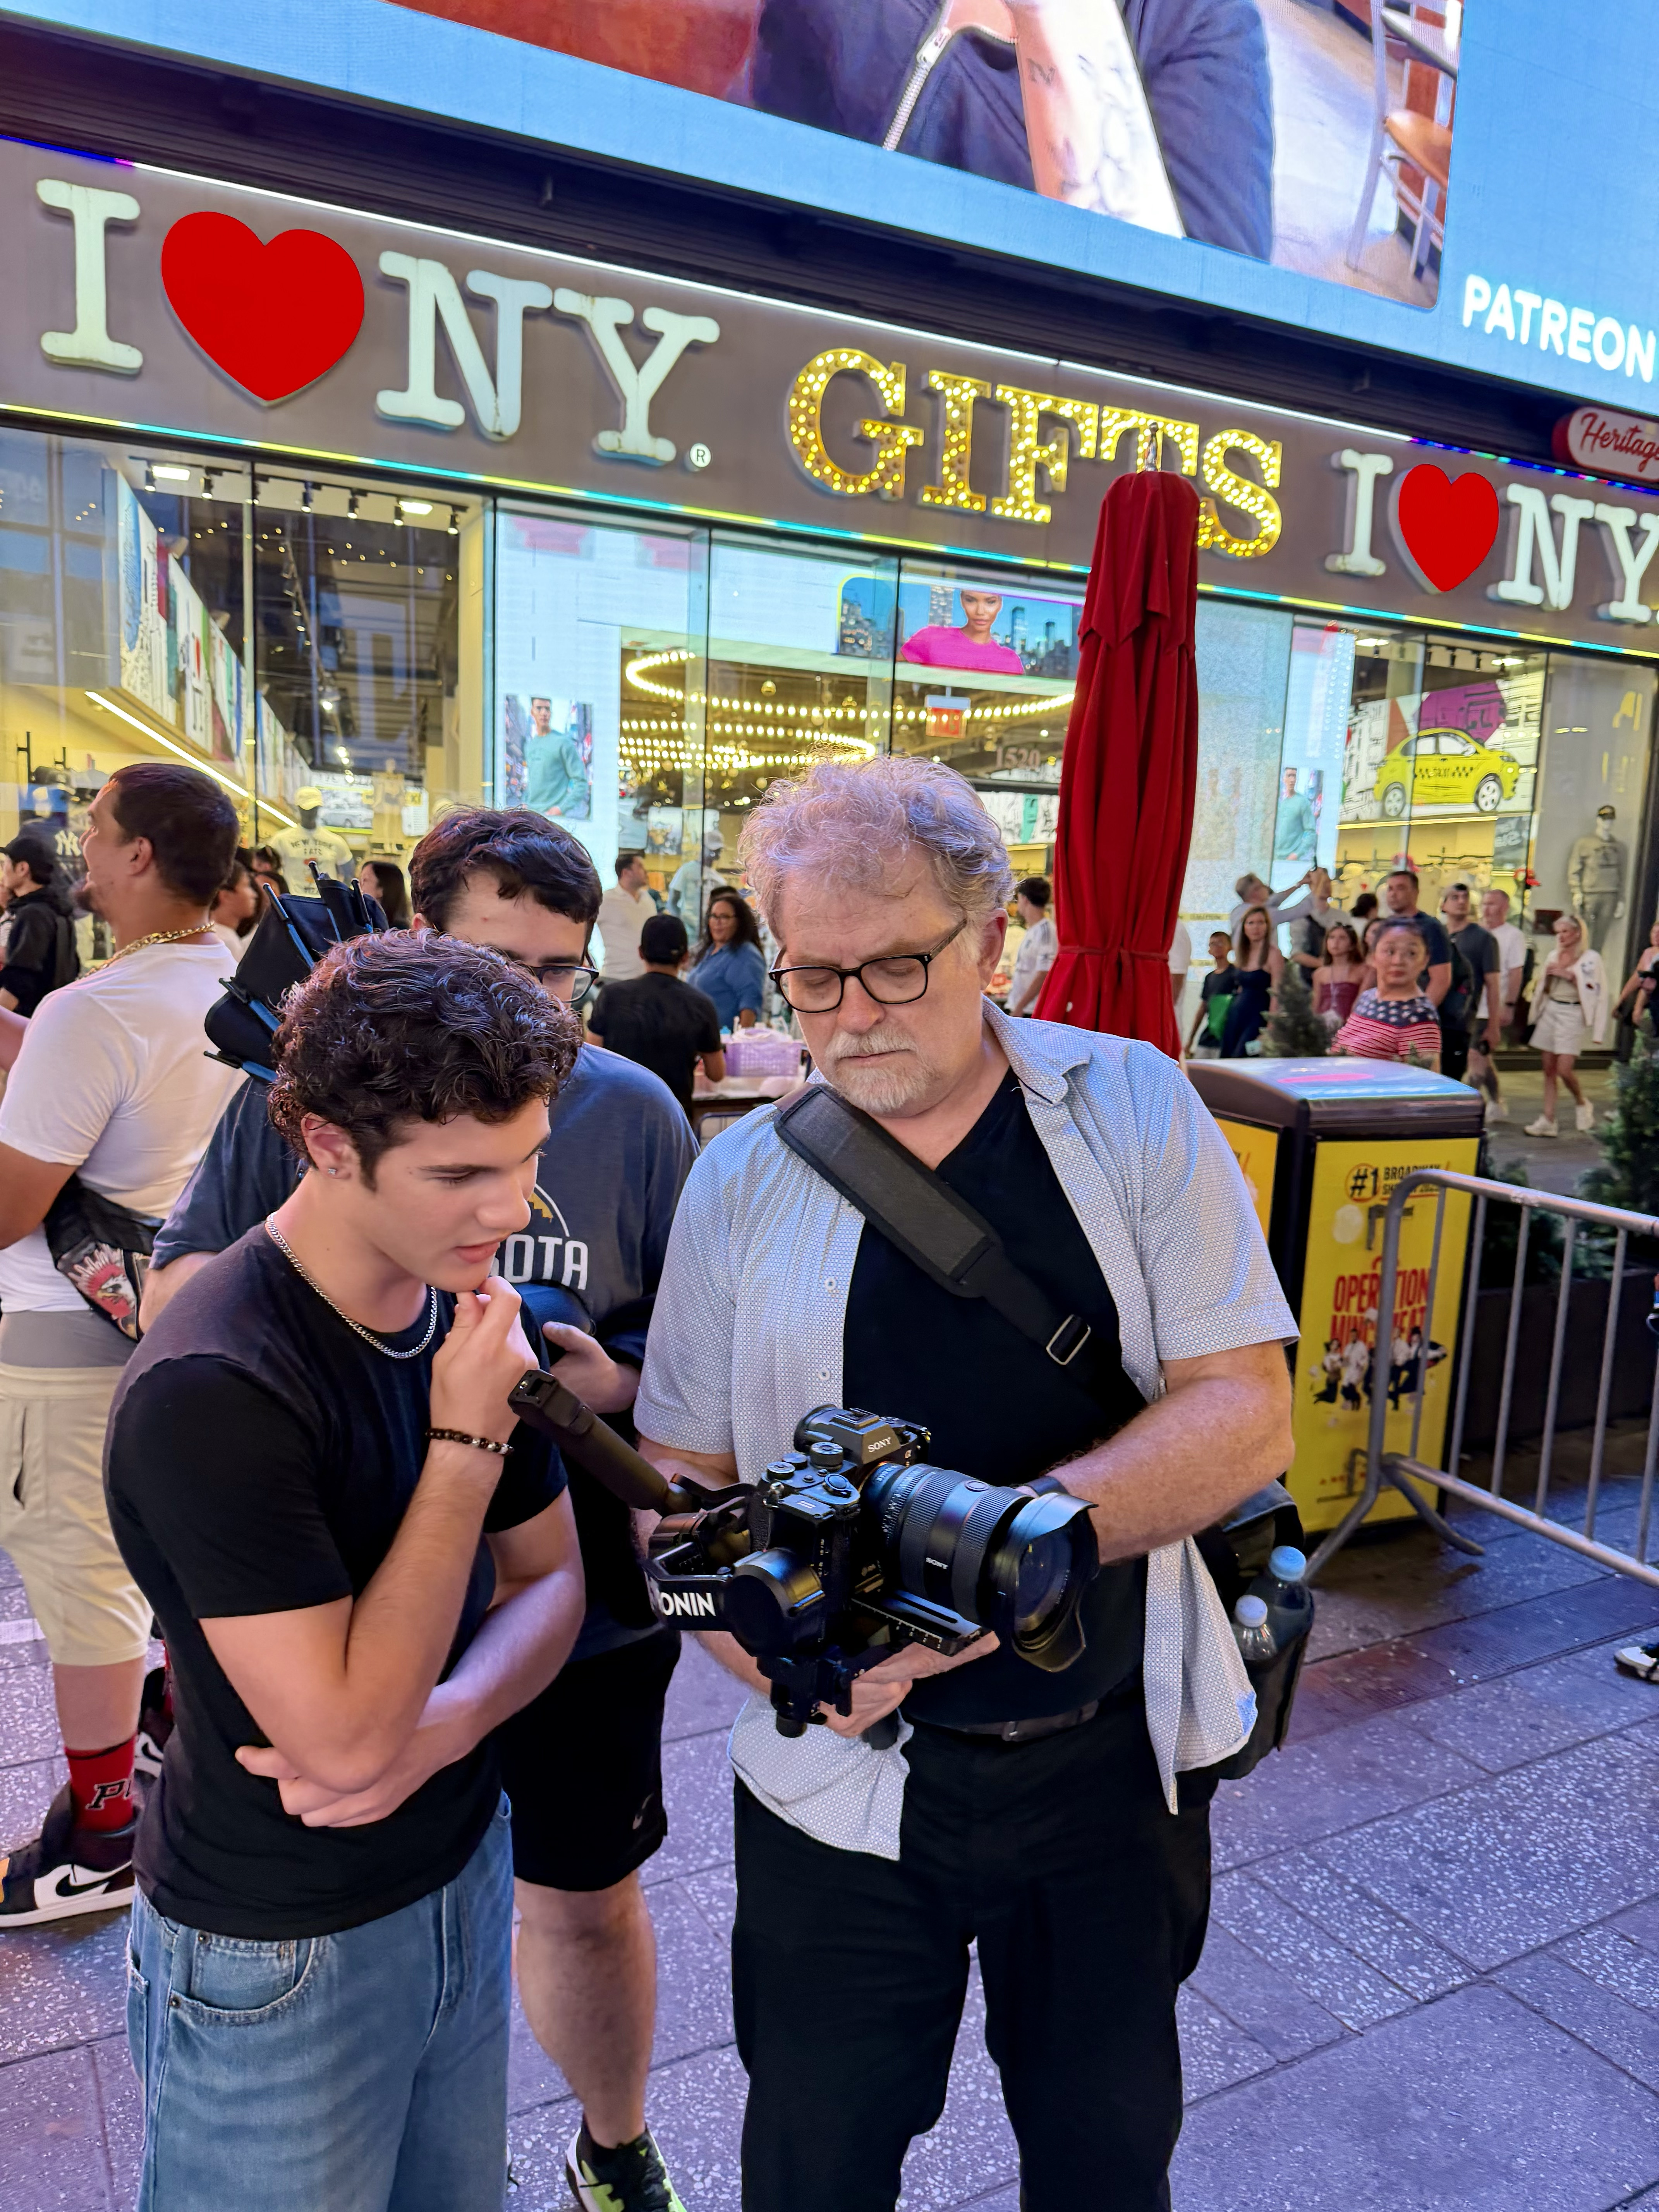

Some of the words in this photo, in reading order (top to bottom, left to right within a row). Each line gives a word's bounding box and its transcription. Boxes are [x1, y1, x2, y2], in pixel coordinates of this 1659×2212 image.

[36, 178, 141, 374] I
[1463, 273, 1656, 383] PATREON
[785, 348, 1283, 558] GIFTS
[1329, 448, 1394, 576] I
[995, 746, 1041, 770] 1520
[1350, 1167, 1378, 1197] #1
[490, 1234, 589, 1290] OTA
[1334, 1268, 1432, 1313] OPERION
[867, 1437, 891, 1453] SONY
[926, 1557, 949, 1570] SONY
[654, 1591, 716, 1617] ONIN
